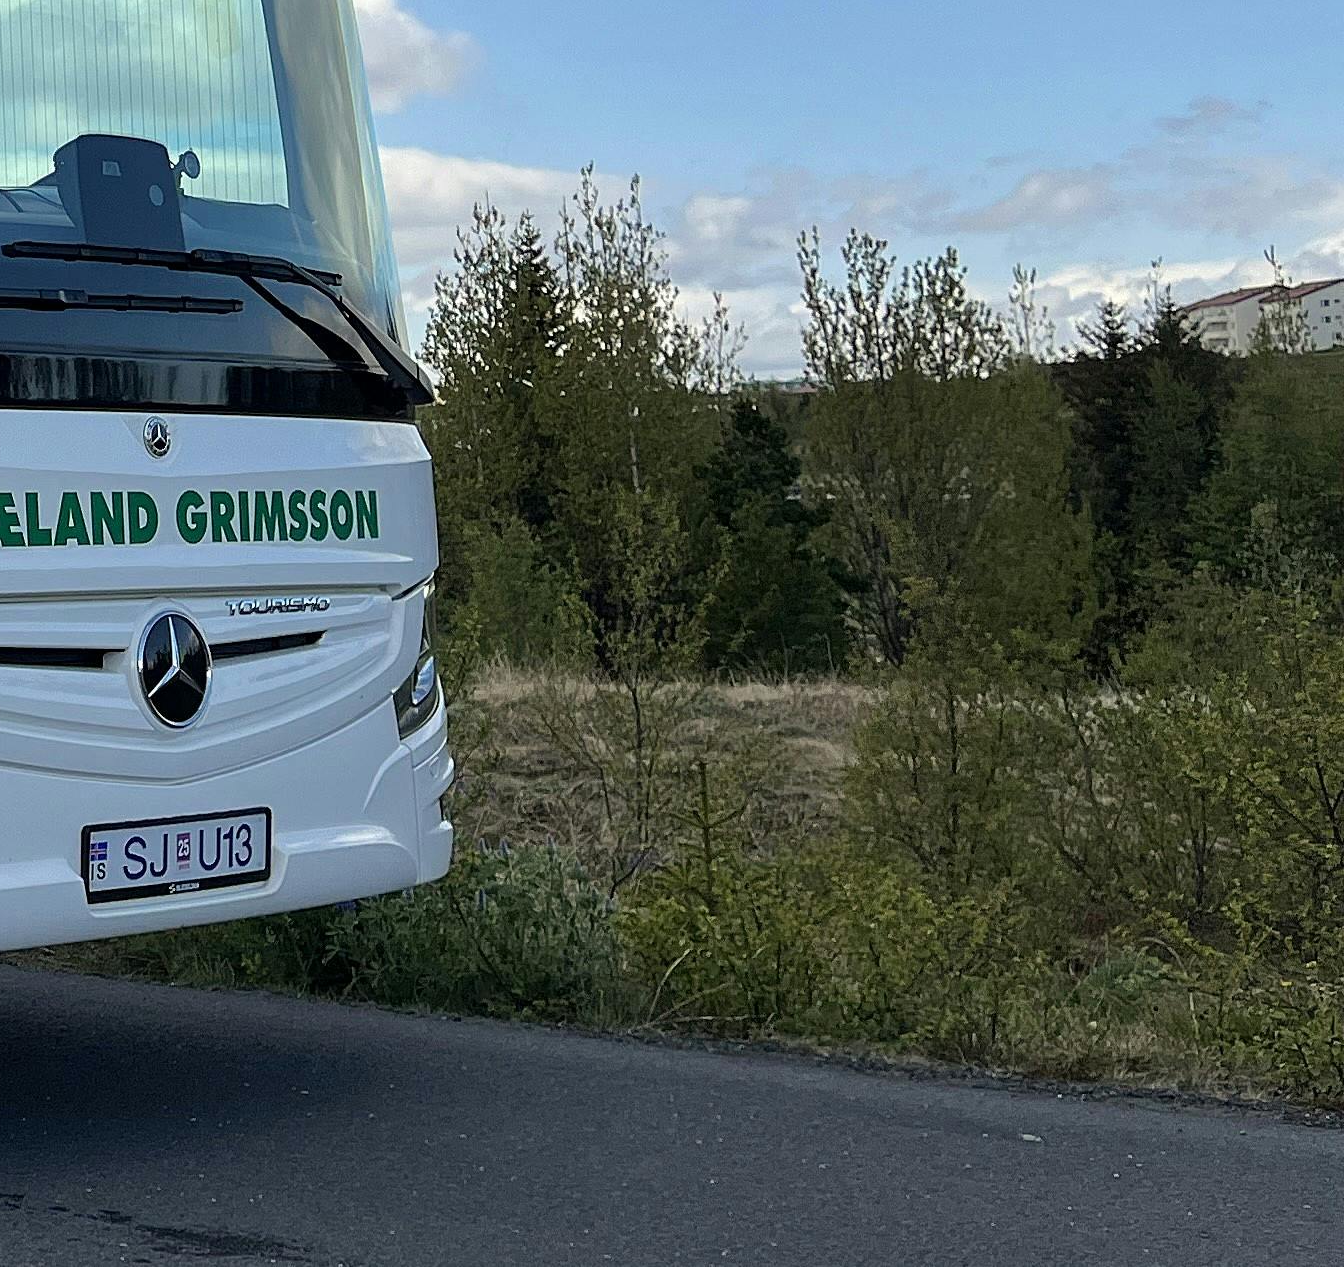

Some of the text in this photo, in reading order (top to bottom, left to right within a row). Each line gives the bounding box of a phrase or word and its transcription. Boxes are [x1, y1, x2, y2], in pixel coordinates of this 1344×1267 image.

[175, 489, 379, 545] GRIMSSON
[225, 596, 330, 616] TOURISMO
[123, 823, 253, 880] SJ U13
[178, 838, 189, 856] 25
[91, 862, 106, 880] IS
